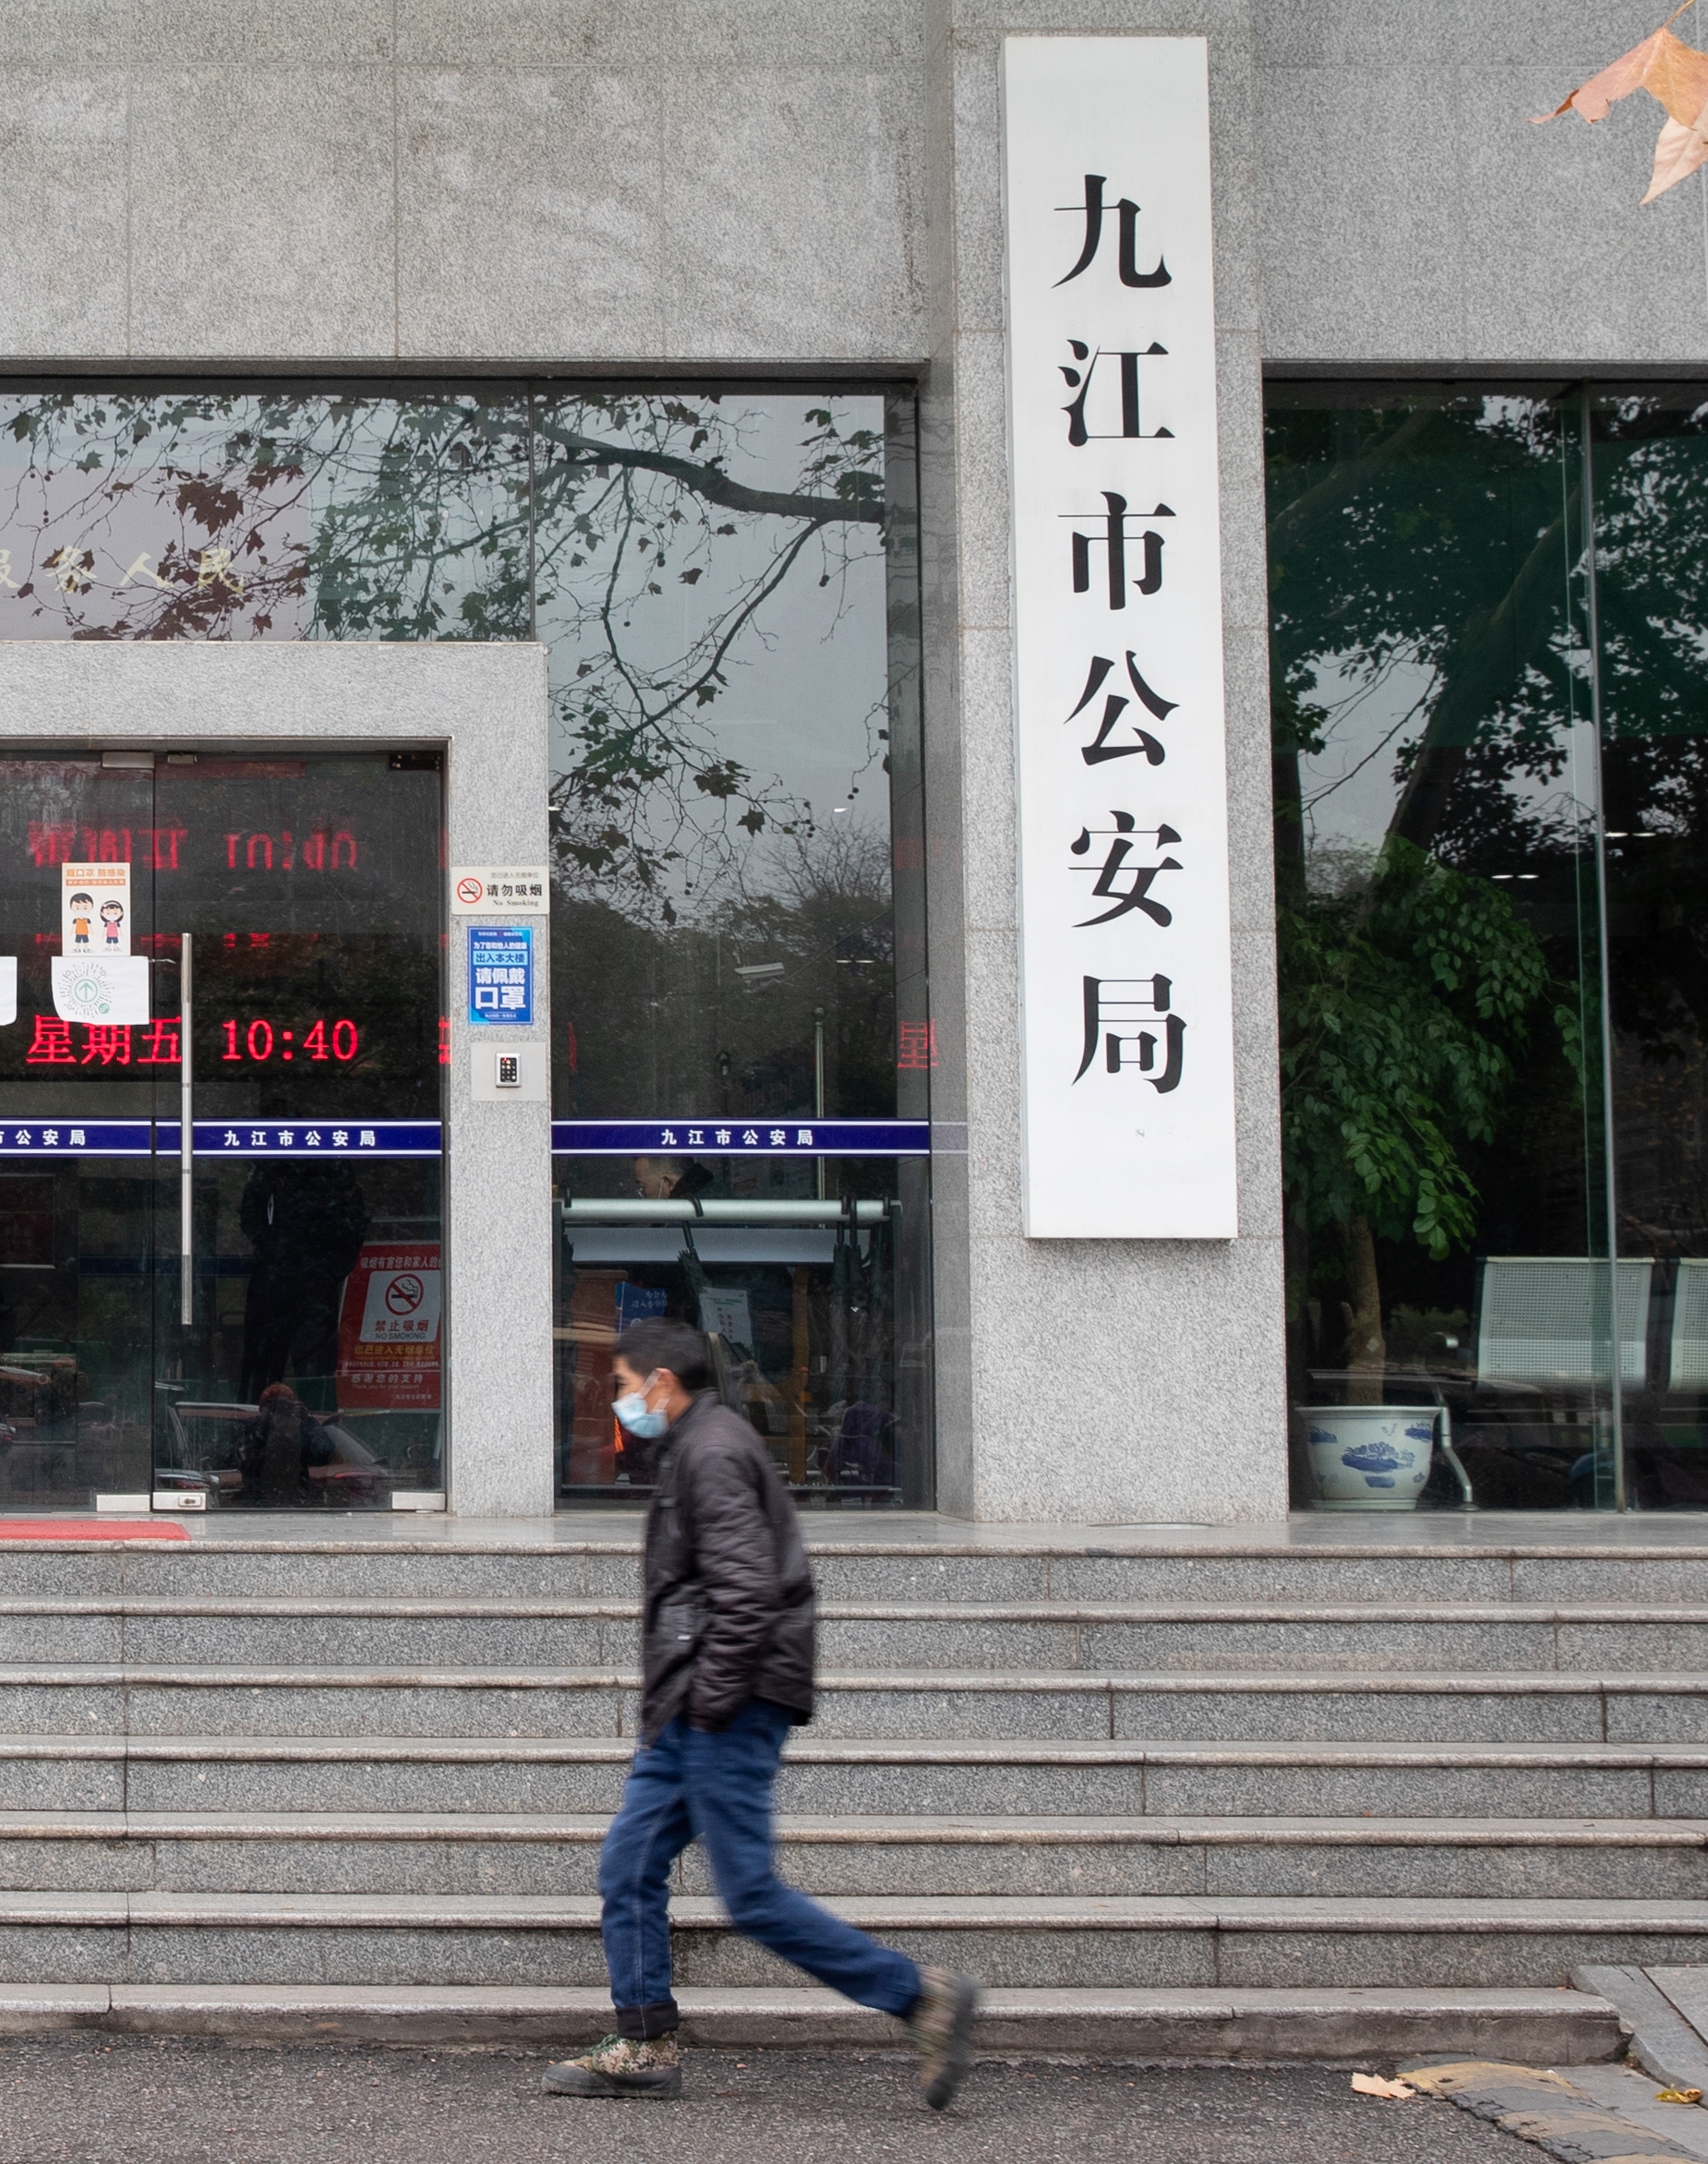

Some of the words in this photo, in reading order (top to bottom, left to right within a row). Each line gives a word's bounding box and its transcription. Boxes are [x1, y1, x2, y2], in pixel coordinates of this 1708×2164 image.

[1051, 174, 1187, 1094] 九江市公安局
[487, 884, 542, 896] 请勿吸烟
[475, 953, 524, 963] 出入本大楼
[475, 967, 525, 984] 请佩戴
[475, 986, 526, 1010] 口罩
[25, 1015, 183, 1064] 星期五
[222, 1018, 359, 1061] 10:40
[224, 1130, 376, 1147] 九江市公安局
[661, 1128, 813, 1146] 九江市公安局
[360, 1256, 441, 1269] 吸烟有害您和家人的
[374, 1319, 429, 1332] 禁止吸烟
[375, 1332, 388, 1340] NO
[354, 1344, 435, 1355] 您已进入无烟单位
[351, 1373, 424, 1384] 感谢您的支持
